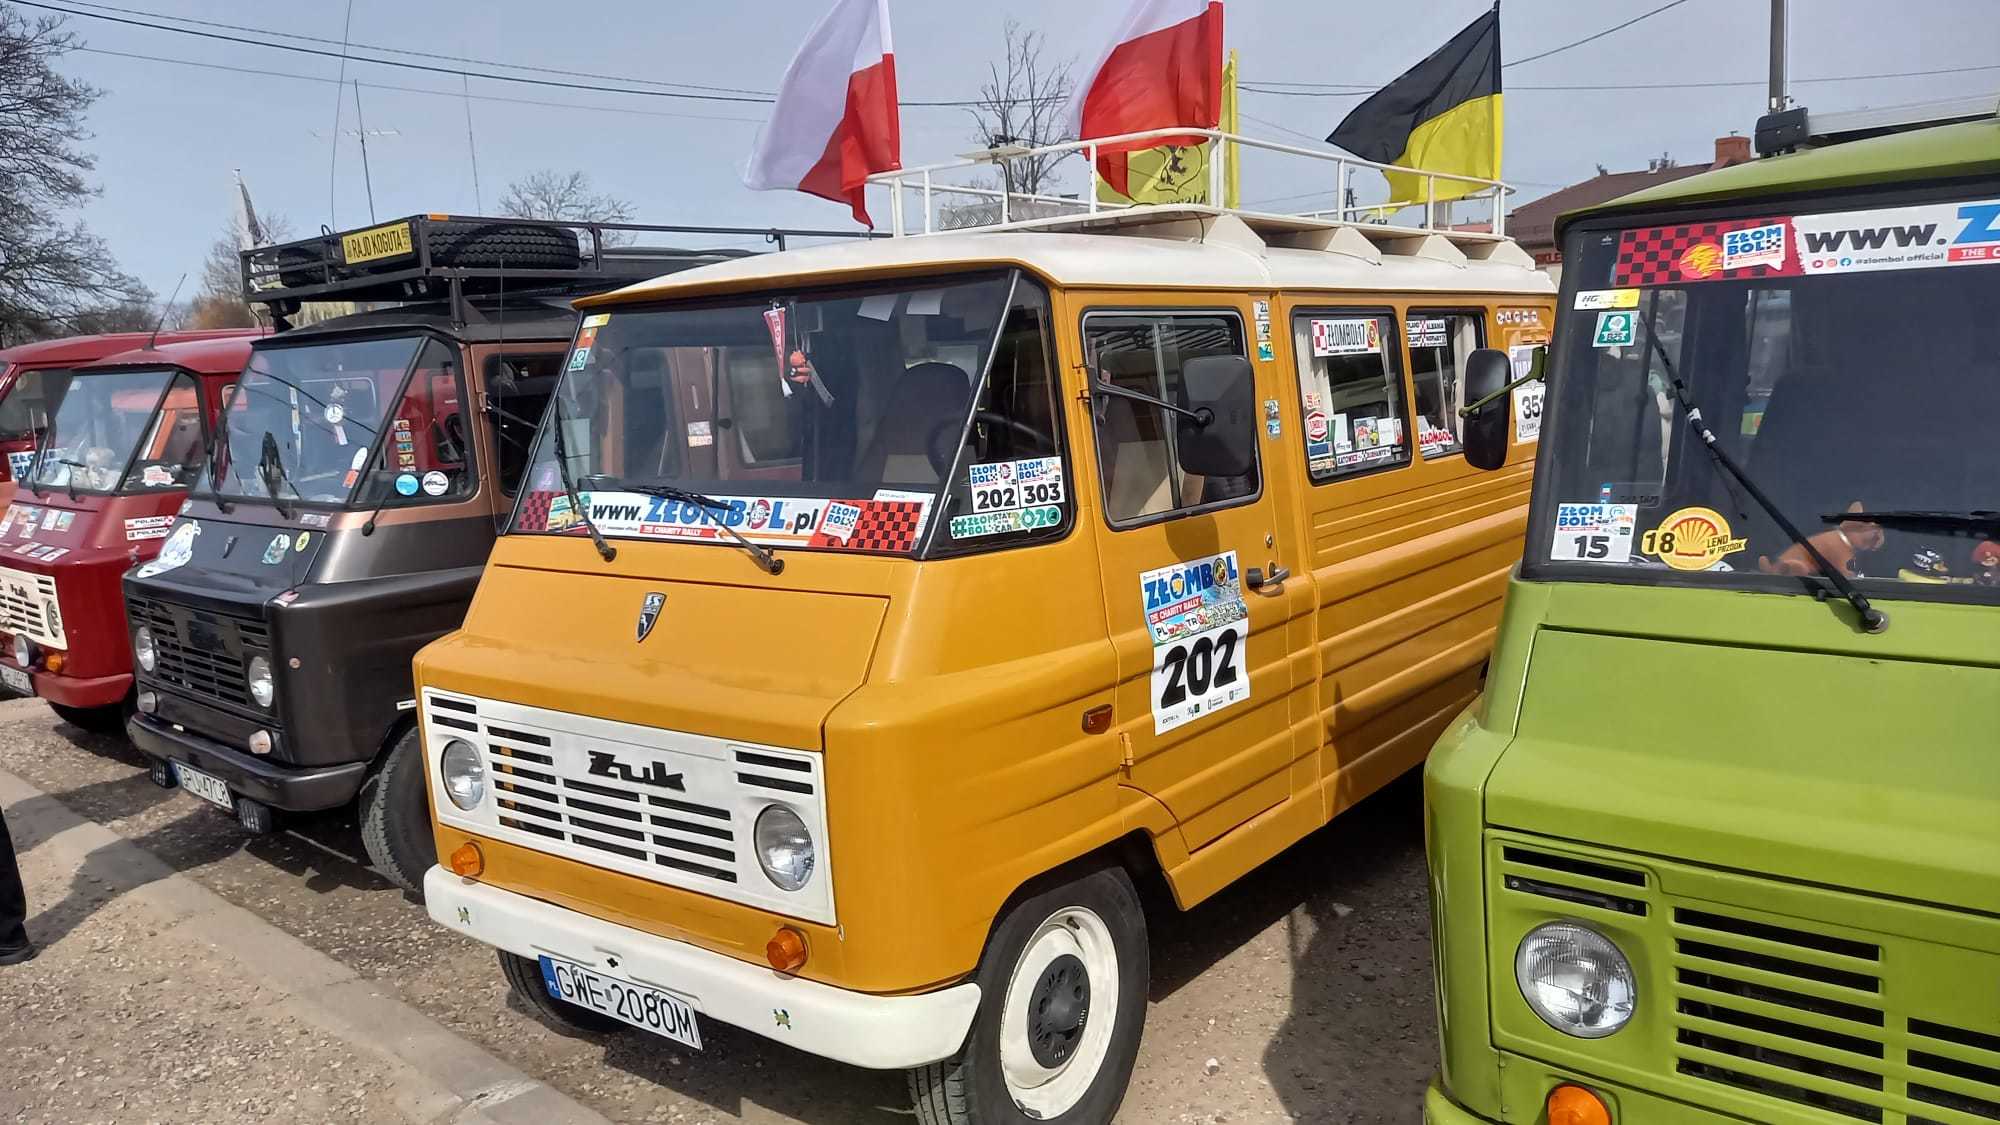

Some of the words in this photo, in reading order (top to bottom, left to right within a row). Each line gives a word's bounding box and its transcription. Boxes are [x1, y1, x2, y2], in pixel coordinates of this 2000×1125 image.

[1727, 226, 1782, 244] ZŁOM
[351, 235, 371, 258] RAJD
[371, 230, 403, 255] KOGUTA
[1727, 241, 1764, 256] BOL
[1960, 247, 1986, 257] THE
[970, 464, 997, 475] ZŁOM
[1017, 460, 1042, 471] ZŁOM
[971, 475, 991, 484] BOL
[1018, 469, 1038, 480] BOL
[976, 487, 1016, 510] 202
[1023, 482, 1061, 504] 303
[830, 504, 859, 518] ZŁOM
[1559, 506, 1603, 516] ZŁOM
[1558, 516, 1590, 527] BOL
[1574, 535, 1610, 559] 15
[1646, 532, 1675, 554] 18
[1186, 617, 1198, 627] TR
[1156, 625, 1168, 637] PL
[1161, 628, 1238, 709] 202
[556, 966, 607, 1010] GWE
[611, 983, 695, 1043] 2080M
